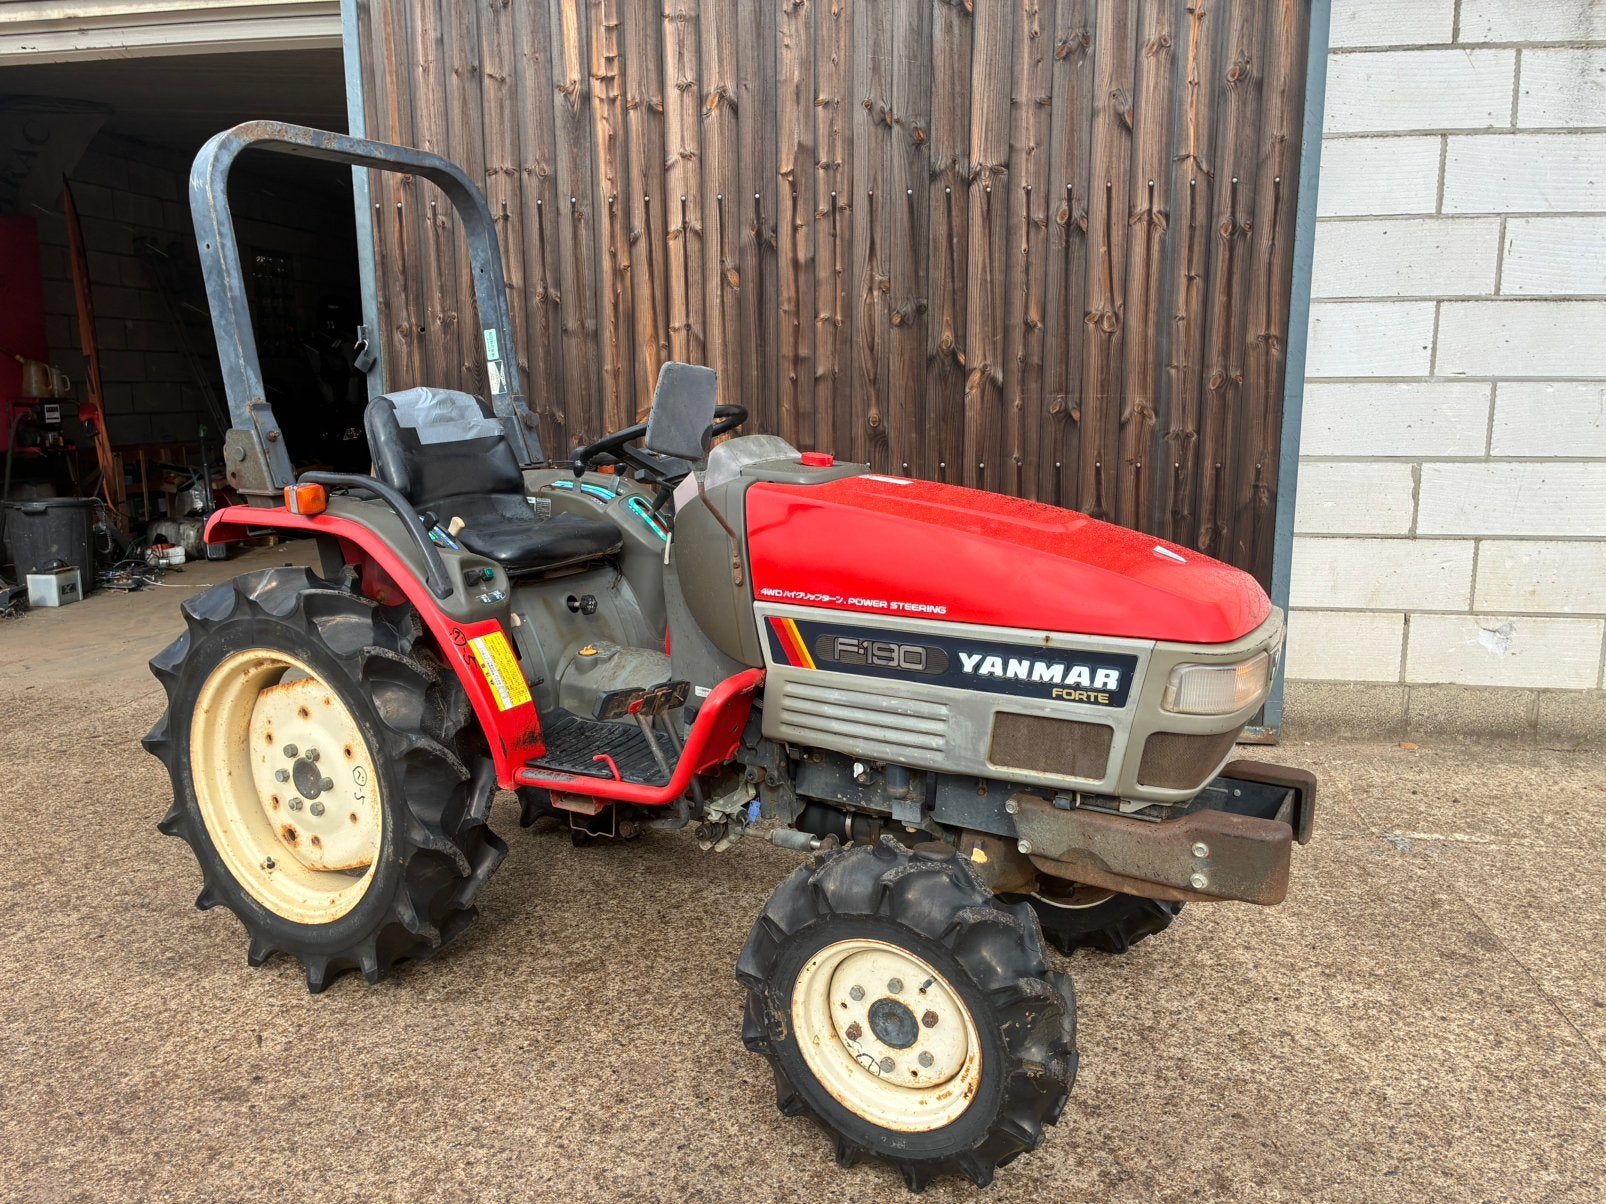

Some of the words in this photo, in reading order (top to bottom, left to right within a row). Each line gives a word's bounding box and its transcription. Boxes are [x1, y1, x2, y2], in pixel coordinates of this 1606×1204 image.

[760, 587, 783, 597] 4WD
[848, 598, 888, 609] POWER
[890, 601, 947, 614] STEERING
[958, 652, 1120, 690] YANMAR
[1052, 687, 1109, 704] FORTE
